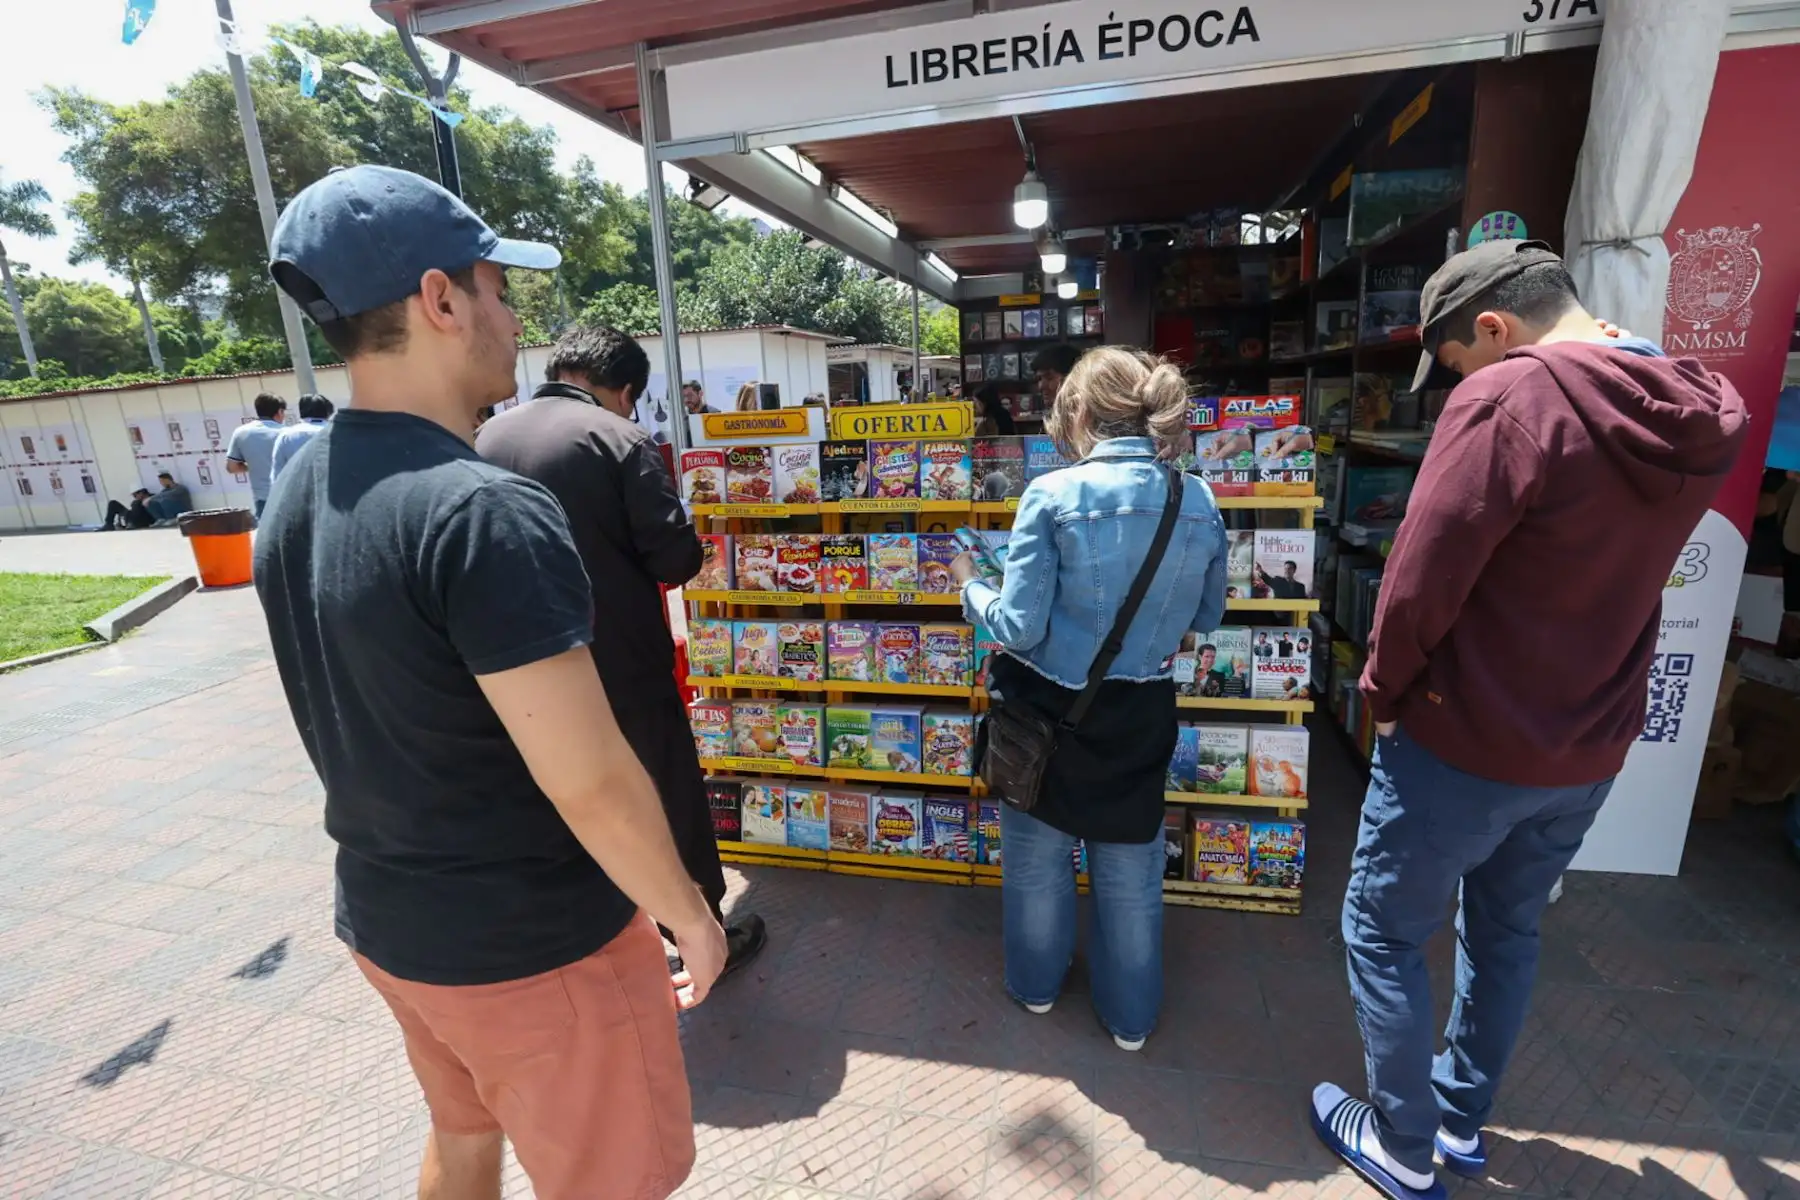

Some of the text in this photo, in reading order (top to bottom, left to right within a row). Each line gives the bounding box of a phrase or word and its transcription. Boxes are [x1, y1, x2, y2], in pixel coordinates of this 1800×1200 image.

[885, 6, 1261, 89] LIBRERÍA ÉPOCA
[1224, 398, 1294, 413] ATLAS
[723, 415, 787, 431] GASTRONOMÍA
[853, 414, 949, 435] OFERTA
[822, 444, 865, 457] Ajedrez
[685, 455, 719, 469] PERUANA
[728, 451, 765, 466] Cocina
[779, 450, 812, 467] Cocina
[744, 548, 770, 558] CHEF
[823, 544, 861, 556] PORQUÉ
[1661, 618, 1700, 629] torial
[927, 635, 960, 654] Lectura
[691, 708, 727, 722] DIETAS
